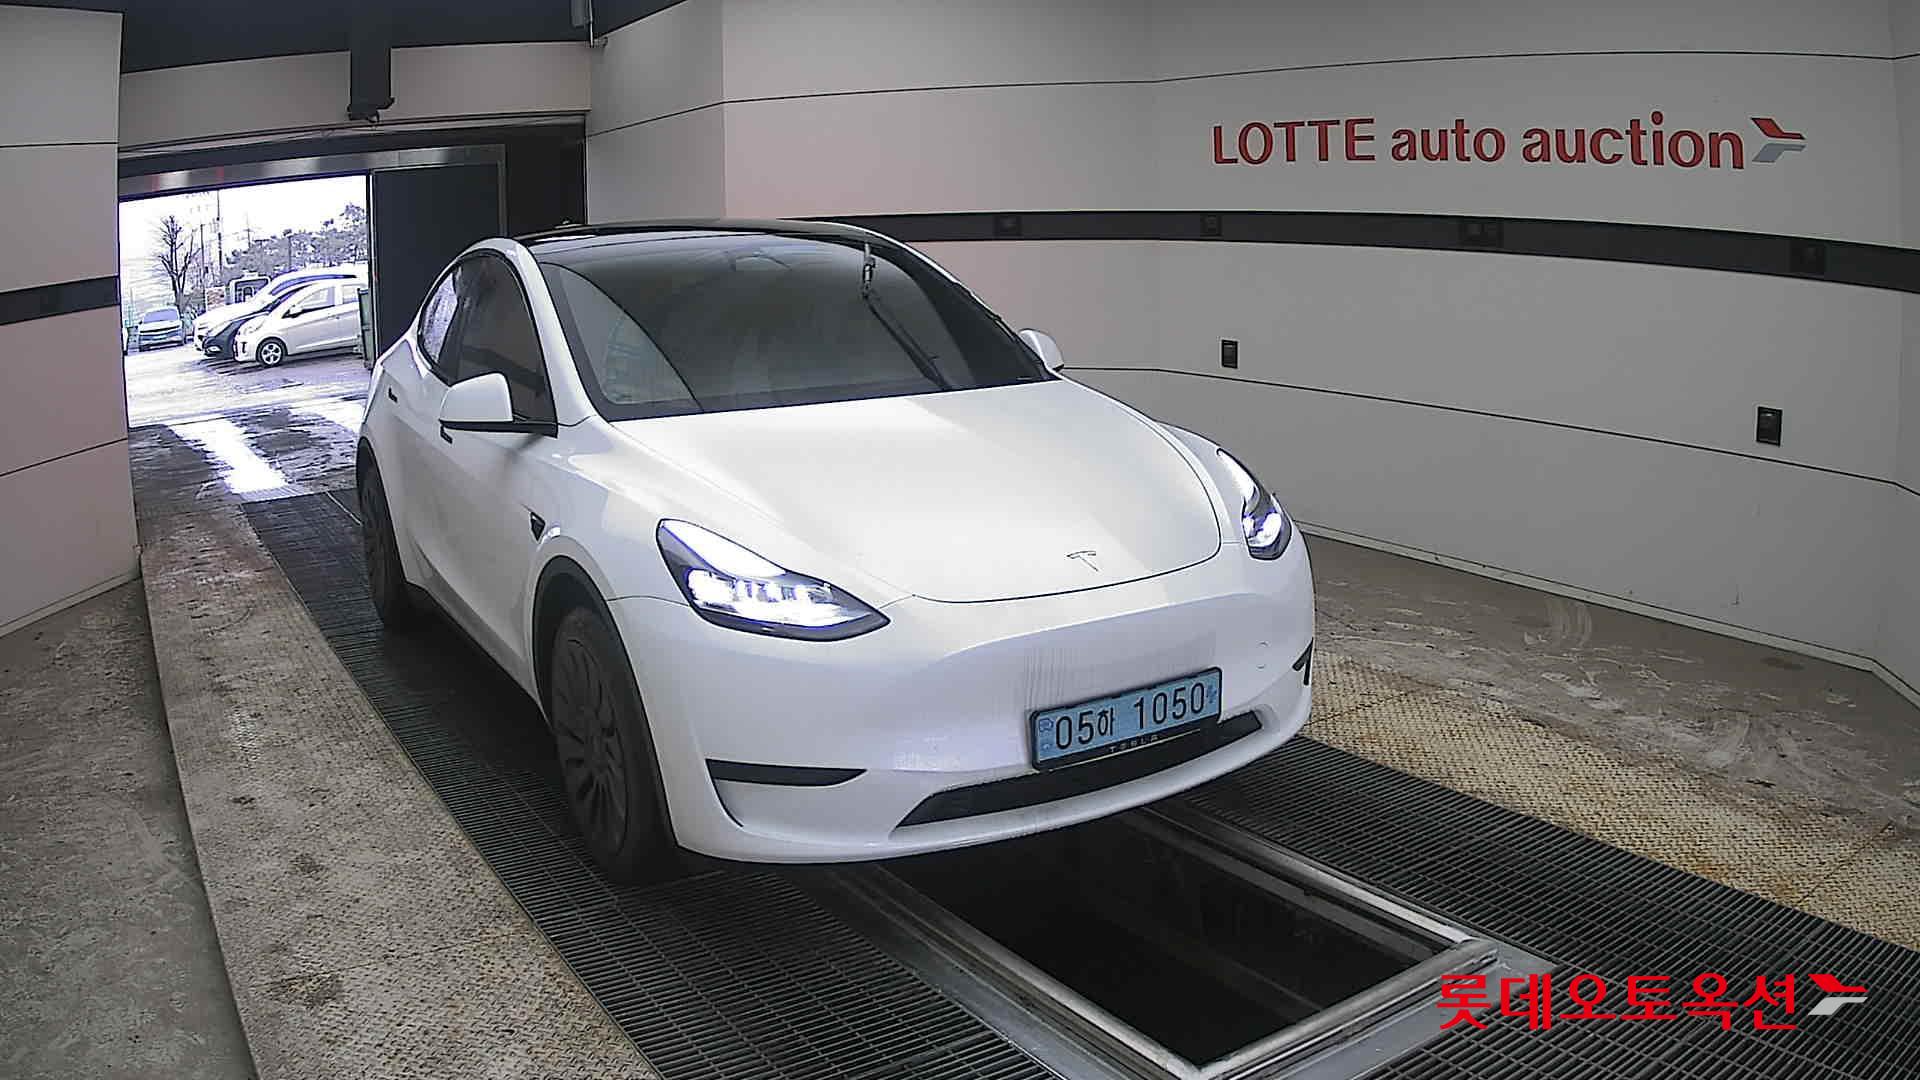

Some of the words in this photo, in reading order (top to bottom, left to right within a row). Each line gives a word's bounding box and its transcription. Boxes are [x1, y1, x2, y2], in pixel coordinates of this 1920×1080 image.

[1212, 118, 1377, 165] LOTTE
[1390, 118, 1506, 162] auto
[1521, 111, 1745, 169] auction
[1055, 707, 1115, 749] 05하
[1133, 682, 1205, 730] 1050
